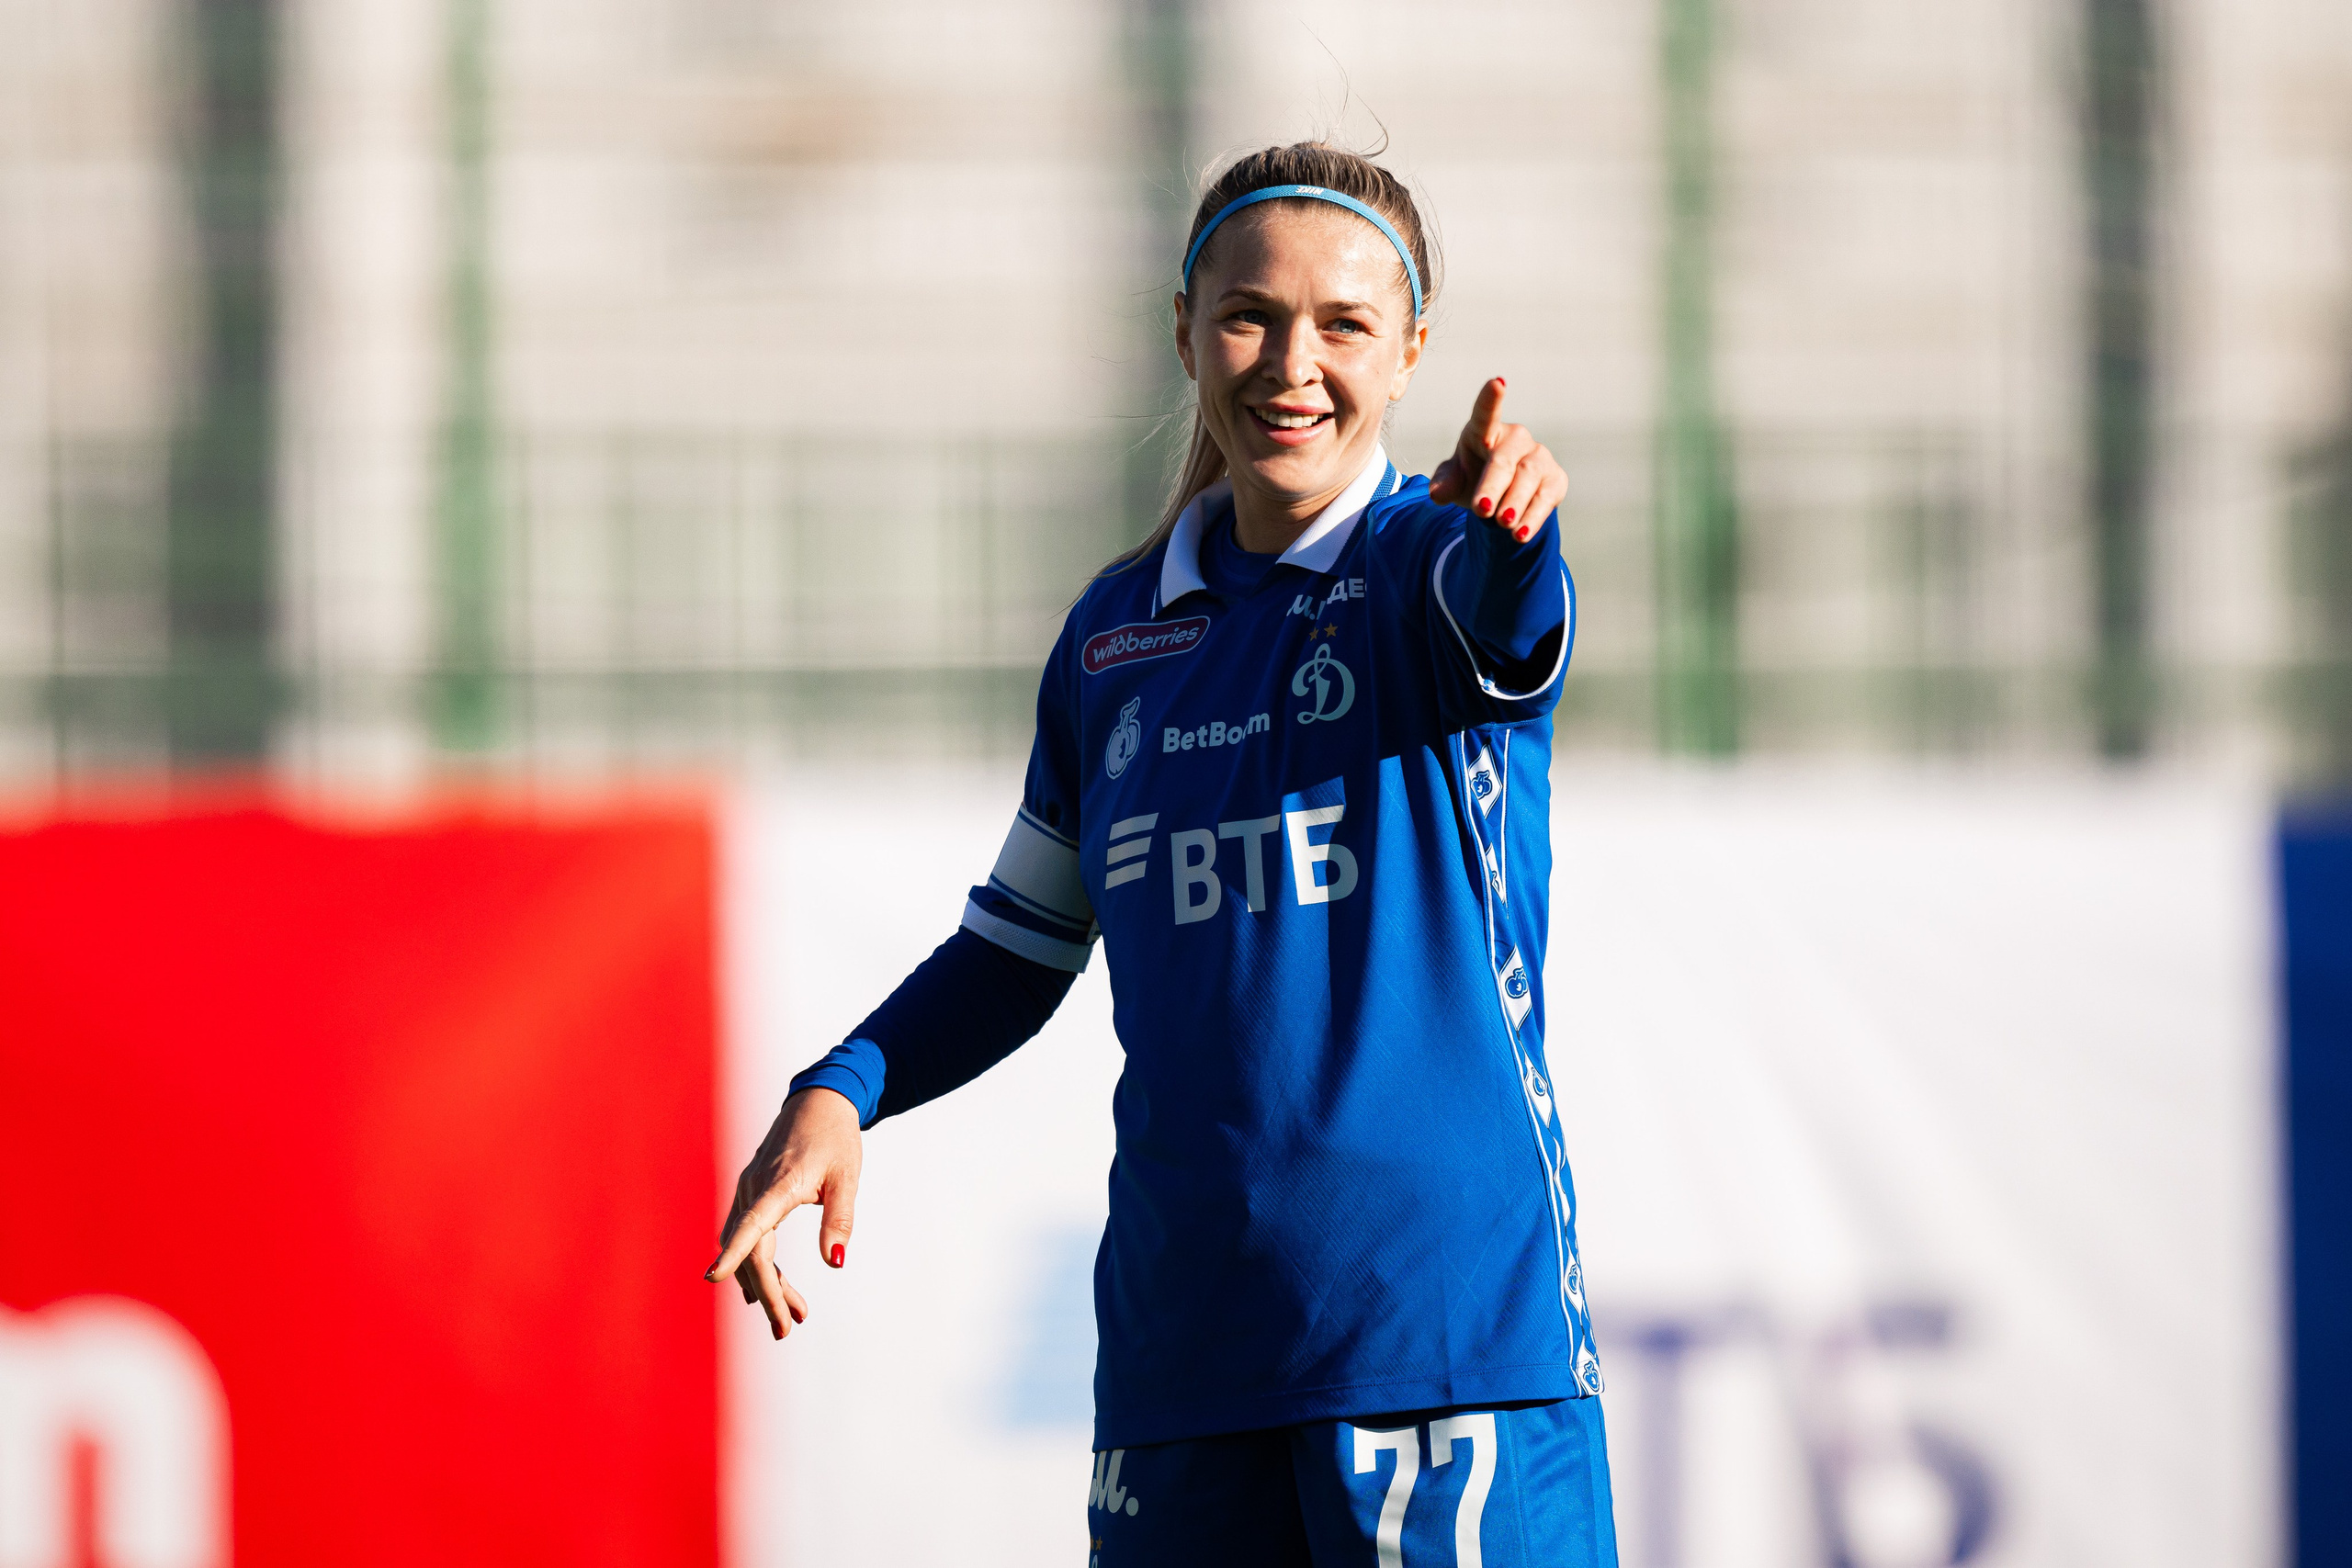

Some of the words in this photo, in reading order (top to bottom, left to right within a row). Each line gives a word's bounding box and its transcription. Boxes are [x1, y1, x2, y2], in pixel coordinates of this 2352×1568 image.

[1286, 578, 1367, 620] М.ДЕ
[1093, 626, 1200, 663] wildberries
[1162, 712, 1271, 753] BetBom
[1353, 1412, 1498, 1568] 77
